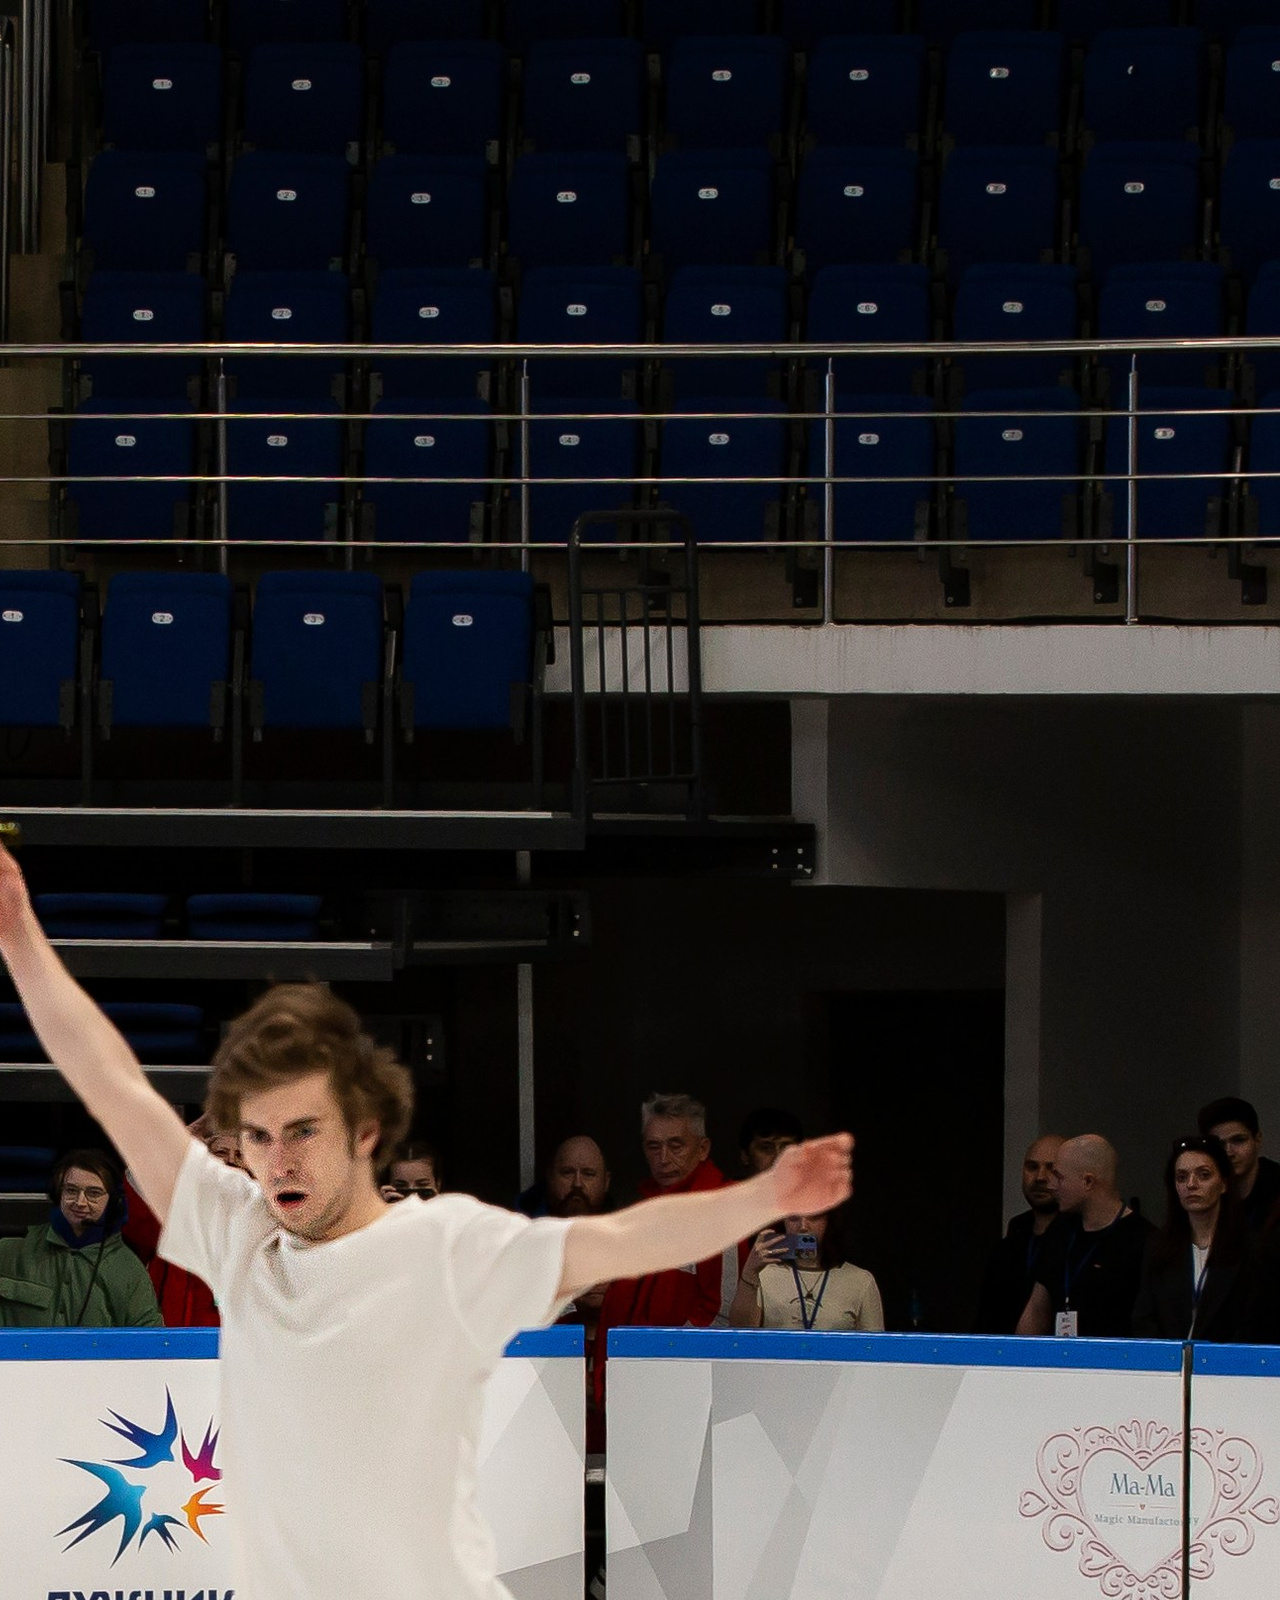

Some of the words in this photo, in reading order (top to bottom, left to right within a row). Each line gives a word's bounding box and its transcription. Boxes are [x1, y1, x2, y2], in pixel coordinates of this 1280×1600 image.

[1109, 1472, 1176, 1497] Ma-Ma
[1094, 1513, 1123, 1526] Magic
[1127, 1515, 1200, 1527] Manufactoy
